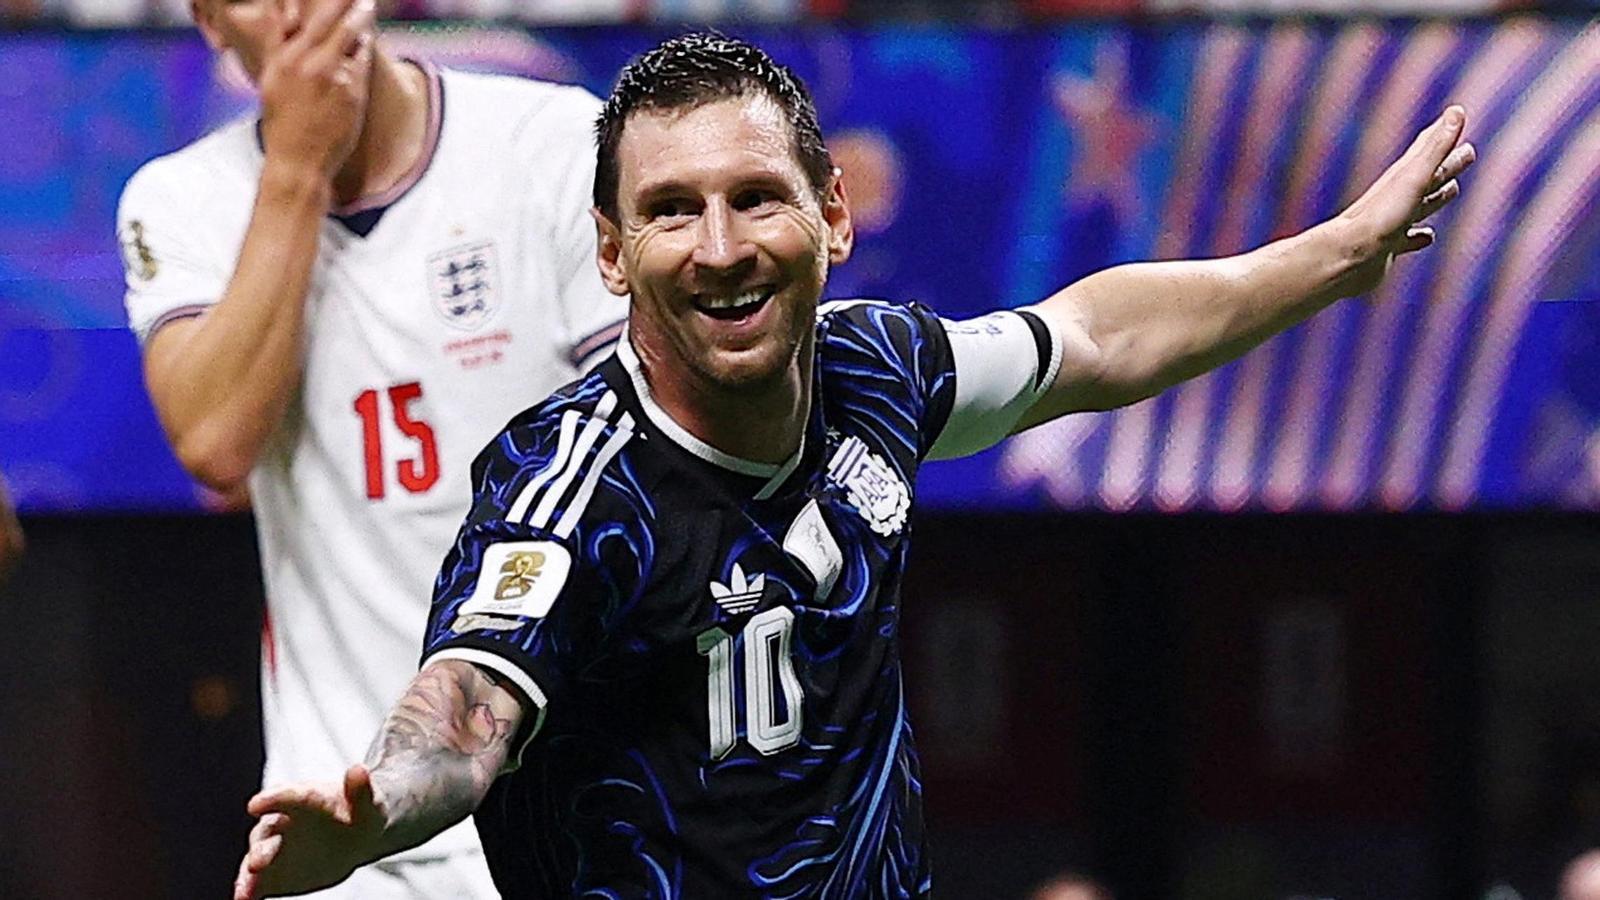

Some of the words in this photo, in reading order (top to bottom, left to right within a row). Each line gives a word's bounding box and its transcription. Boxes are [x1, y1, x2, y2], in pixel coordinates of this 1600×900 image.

[353, 381, 440, 499] 15
[853, 463, 889, 507] AFA
[696, 605, 804, 761] 10
